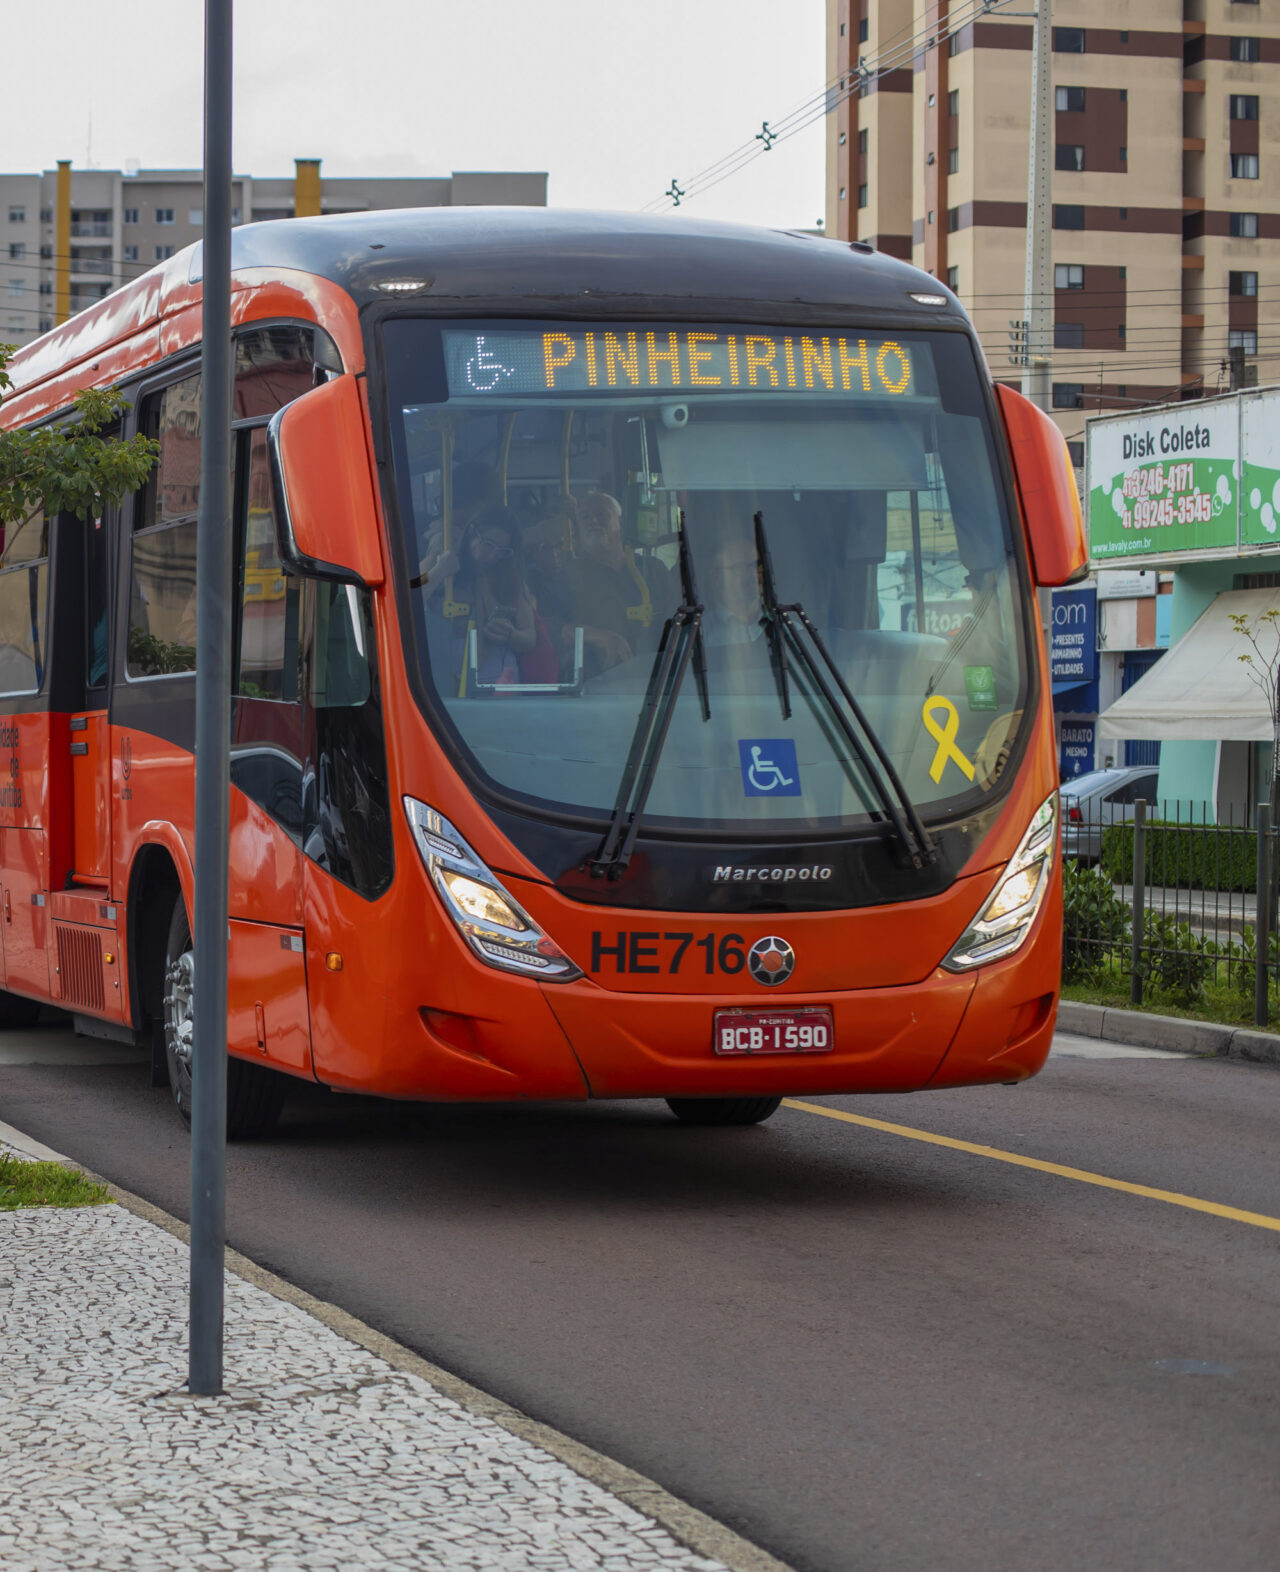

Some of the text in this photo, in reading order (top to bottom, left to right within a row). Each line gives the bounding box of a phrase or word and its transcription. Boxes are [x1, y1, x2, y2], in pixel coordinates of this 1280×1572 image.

[542, 331, 911, 395] PINHEIRINHO
[1123, 423, 1210, 459] Disk Coleta
[1134, 493, 1211, 530] 99245-3545
[1062, 728, 1093, 743] BARATO
[1066, 746, 1088, 757] MESMO
[713, 865, 832, 882] Marcopolo
[591, 930, 745, 975] HE716
